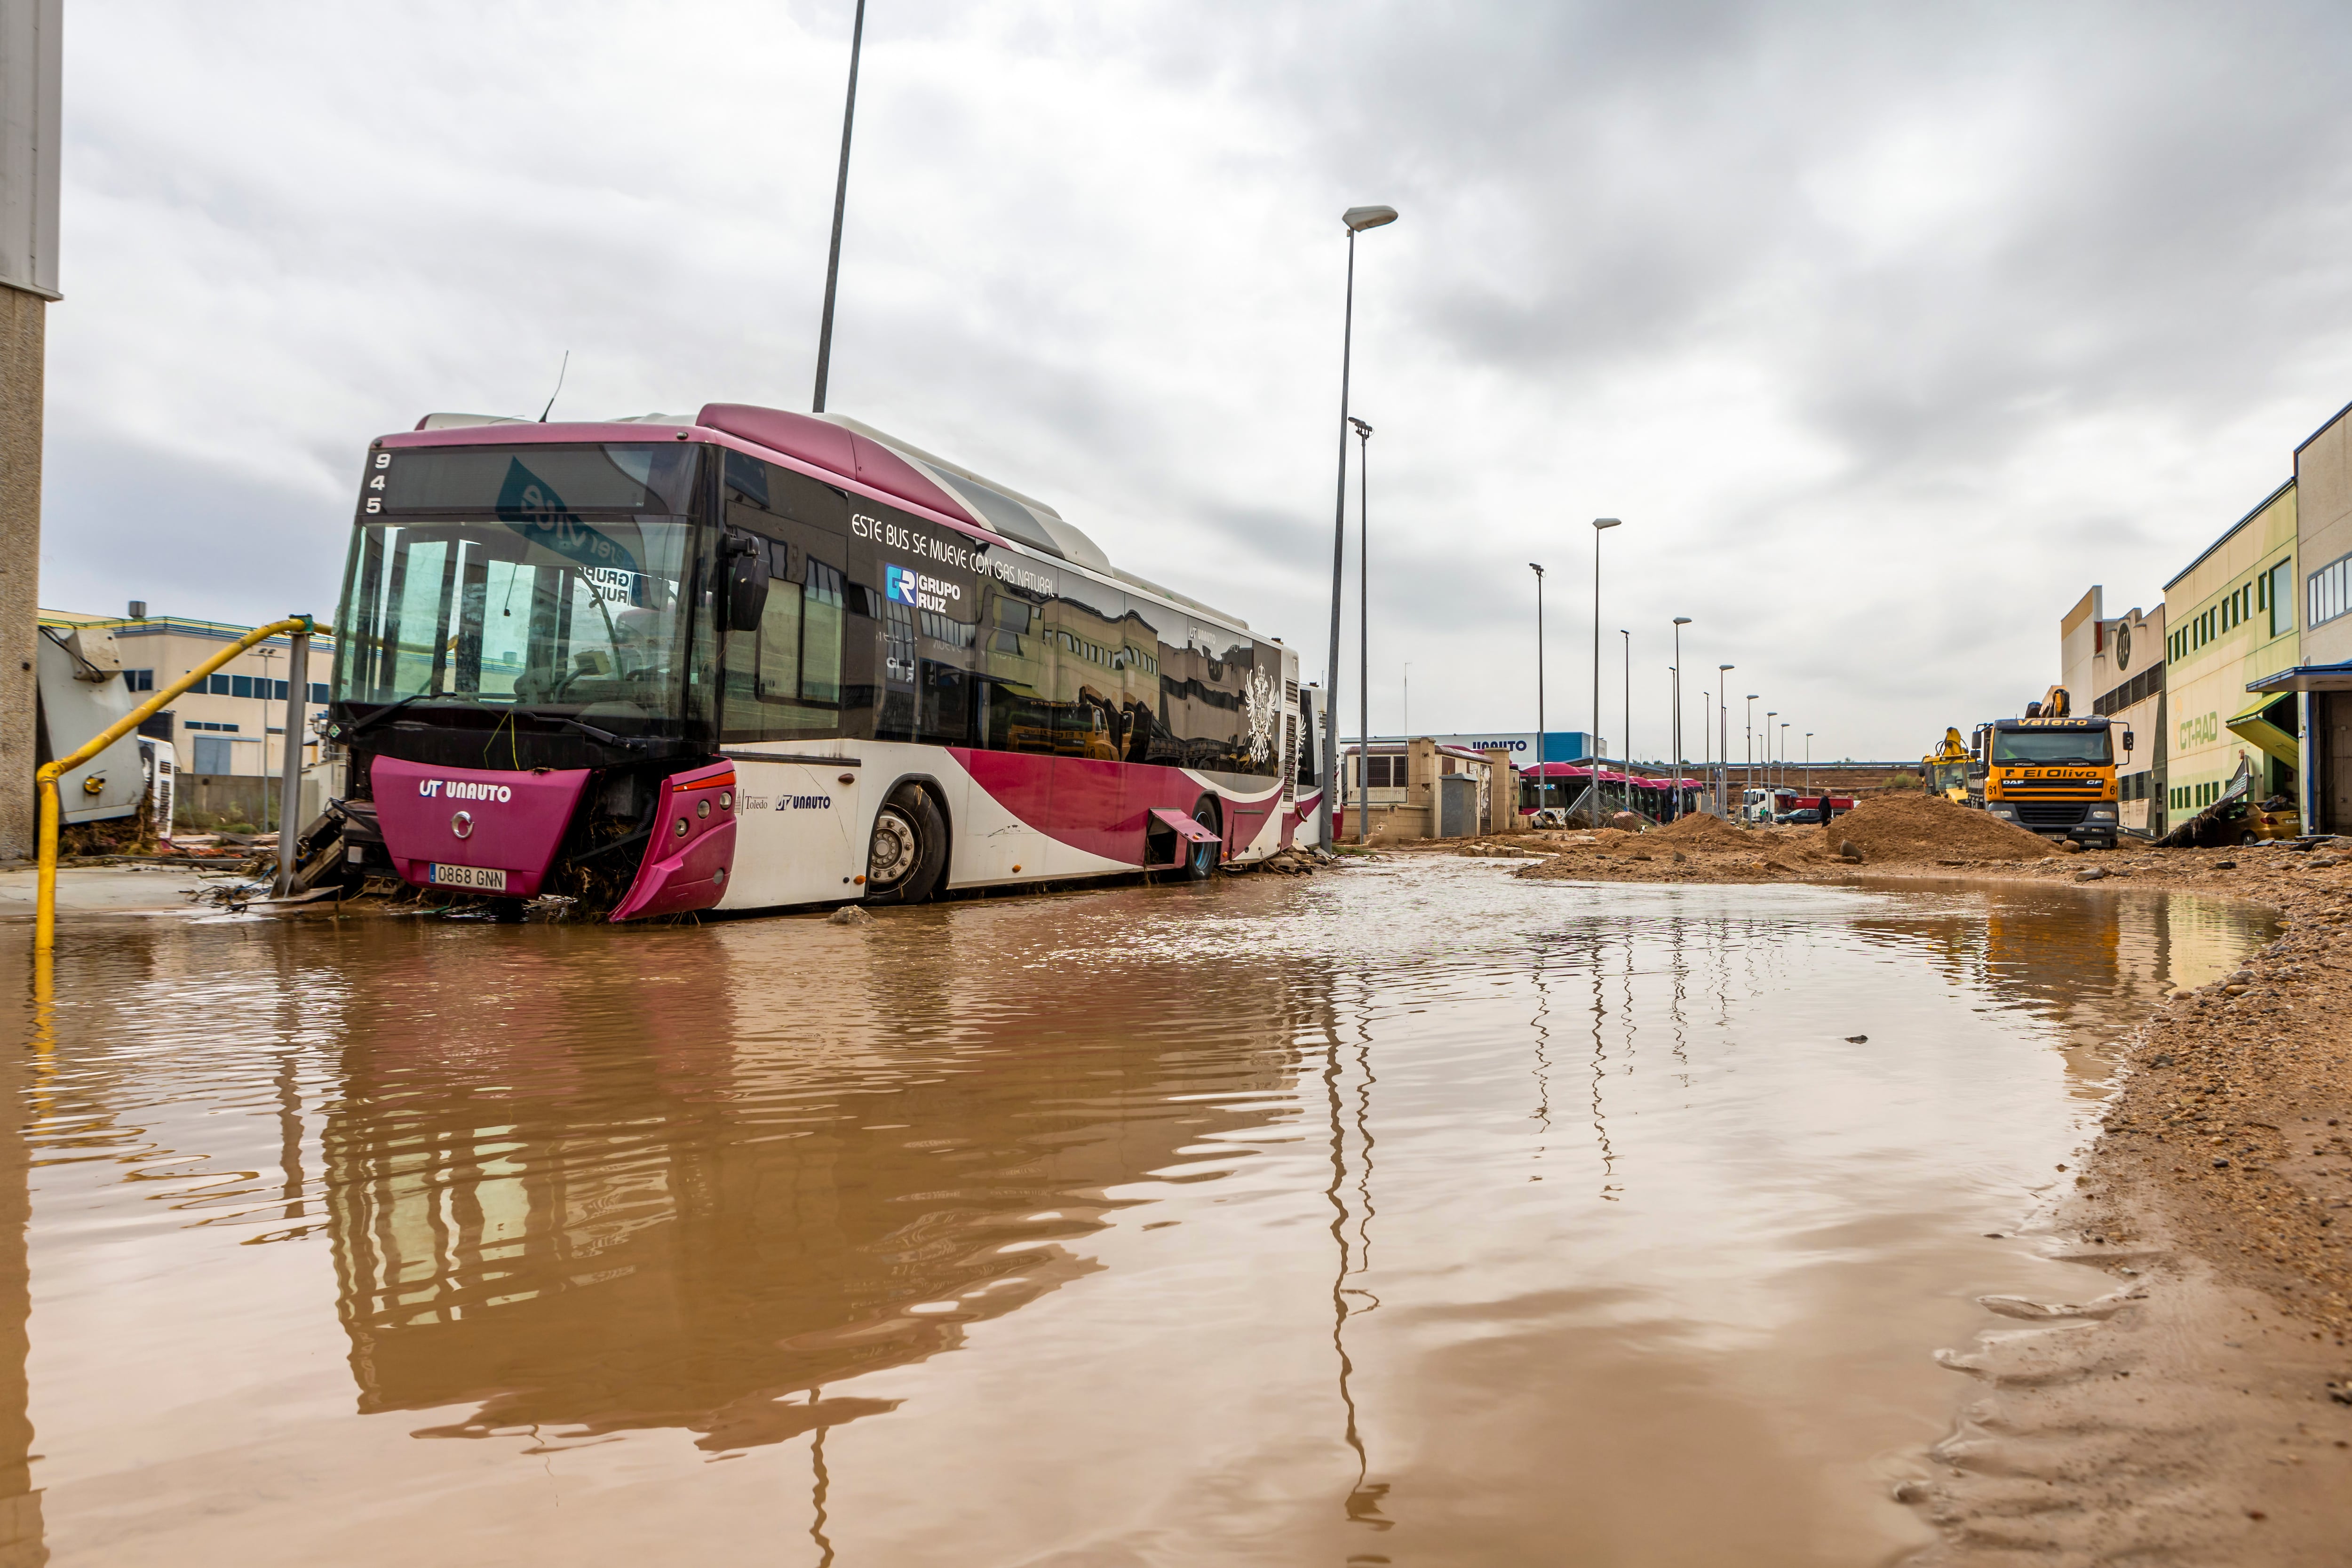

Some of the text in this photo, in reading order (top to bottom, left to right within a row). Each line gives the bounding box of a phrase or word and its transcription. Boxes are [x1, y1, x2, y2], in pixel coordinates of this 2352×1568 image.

[852, 514, 1055, 597] ESTE BUS SE MUEVE CON GAS NATURAL
[918, 575, 961, 600] GRUPO
[918, 592, 946, 613] RUIZ
[1198, 628, 1216, 645] UNAUTO
[2180, 711, 2217, 750] CT-RAD
[2023, 769, 2097, 778] El Olivo
[446, 781, 511, 803] UNAUTO
[1988, 785, 1997, 795] 61
[745, 796, 768, 809] Toledo
[793, 796, 831, 809] UNAUTO
[438, 866, 502, 888] 0868 GNN
